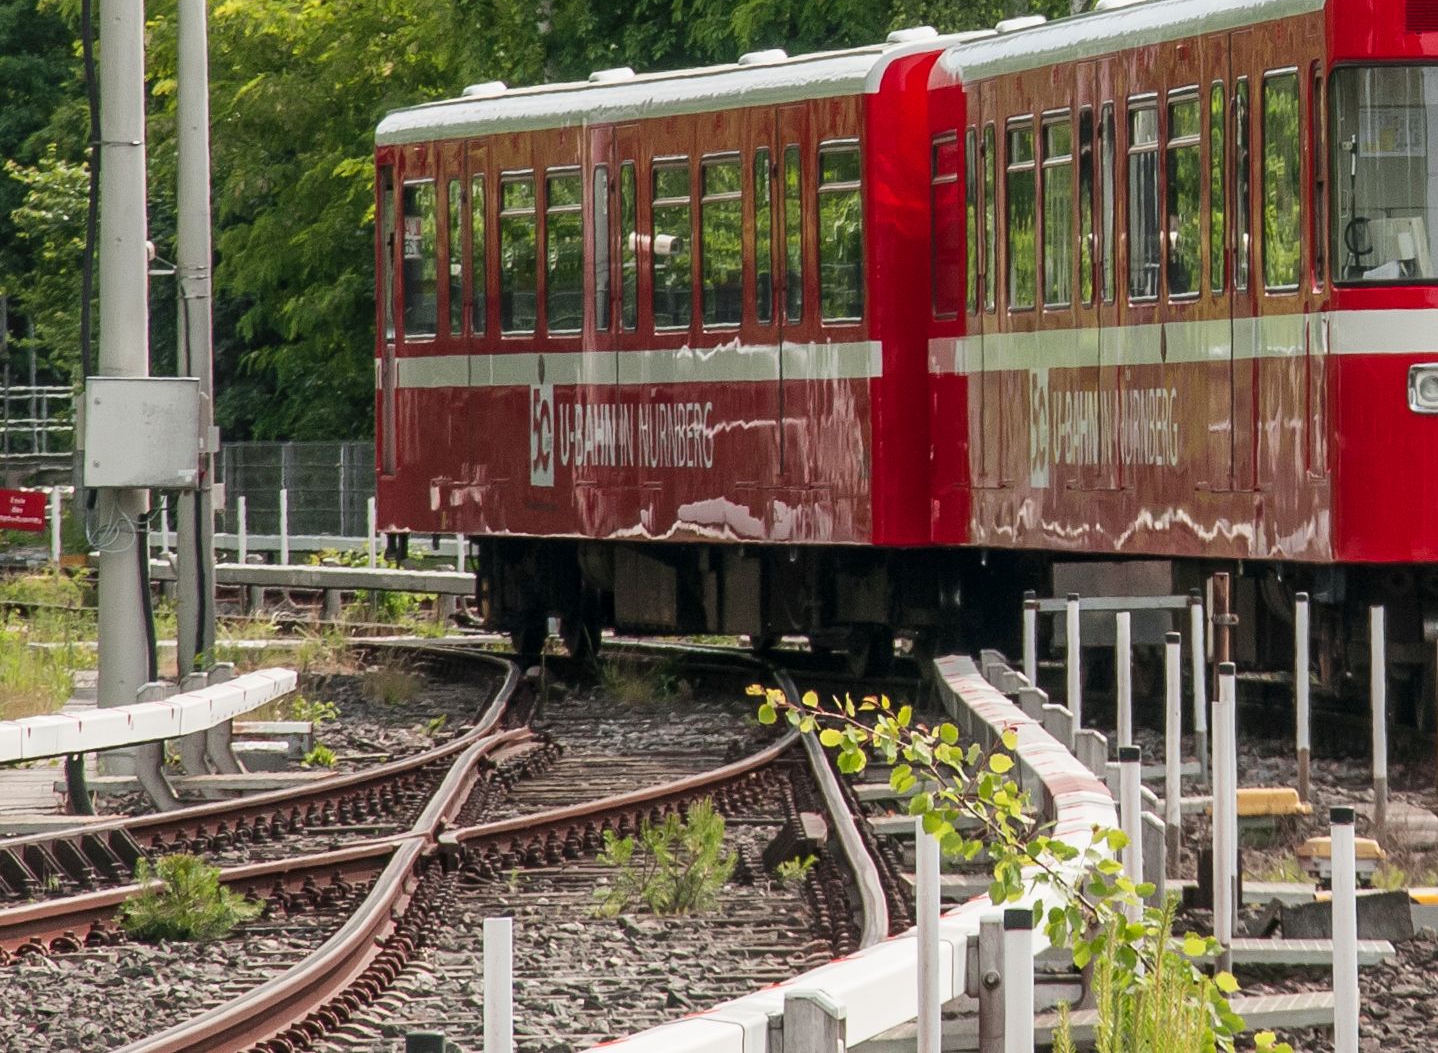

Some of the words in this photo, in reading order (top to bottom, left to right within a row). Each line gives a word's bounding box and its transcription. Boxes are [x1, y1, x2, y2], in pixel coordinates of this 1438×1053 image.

[559, 403, 616, 467] U-BAHN
[619, 403, 634, 467] IN
[1052, 389, 1099, 466] U-BAHN
